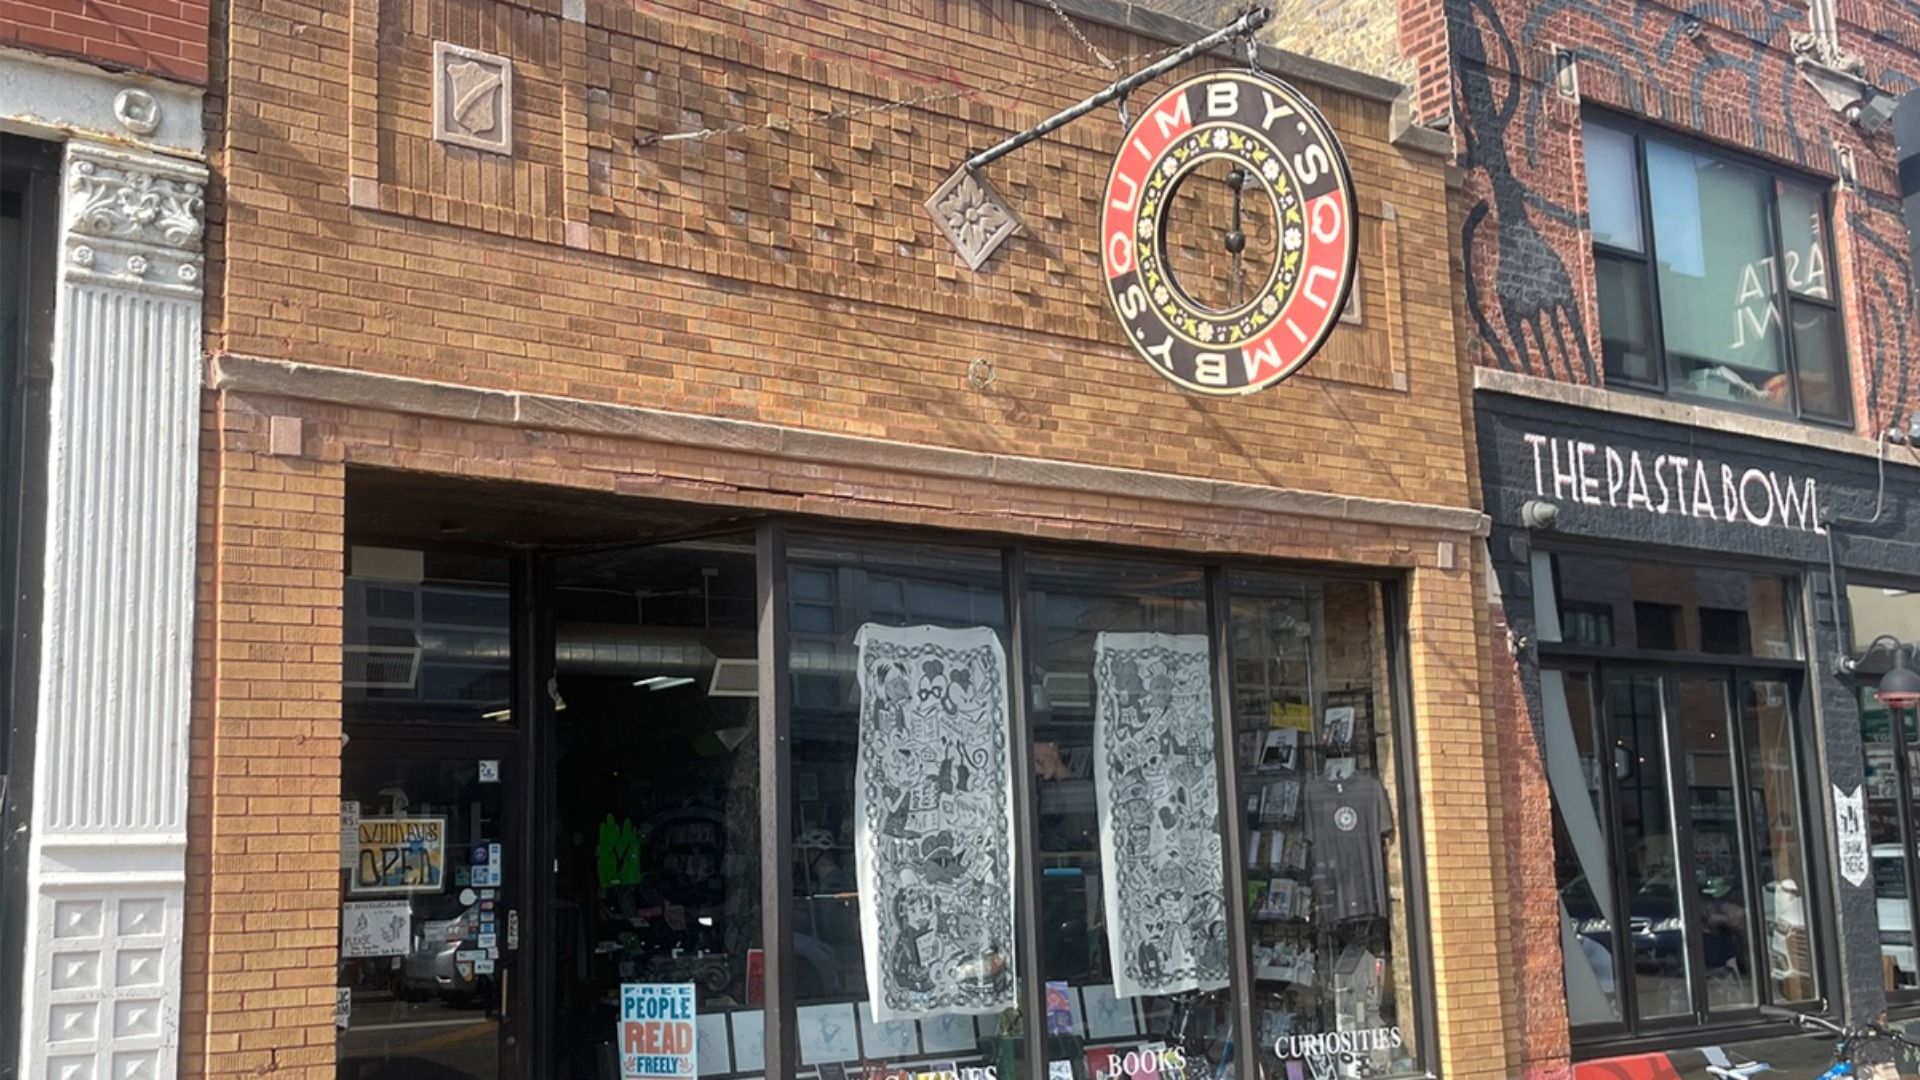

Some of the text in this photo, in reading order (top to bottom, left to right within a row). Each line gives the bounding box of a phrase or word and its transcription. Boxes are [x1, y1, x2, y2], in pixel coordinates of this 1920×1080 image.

[1109, 81, 1330, 275] QUIMBY'S
[1118, 198, 1342, 386] QUIMBY'S
[1524, 433, 1827, 535] THE PASTA BOWL
[624, 997, 691, 1019] PEOPLE
[624, 1021, 694, 1055] READ
[1274, 1026, 1402, 1060] CURIOSITIES
[637, 1056, 679, 1074] FREELY
[1107, 1046, 1188, 1078] BOOKS
